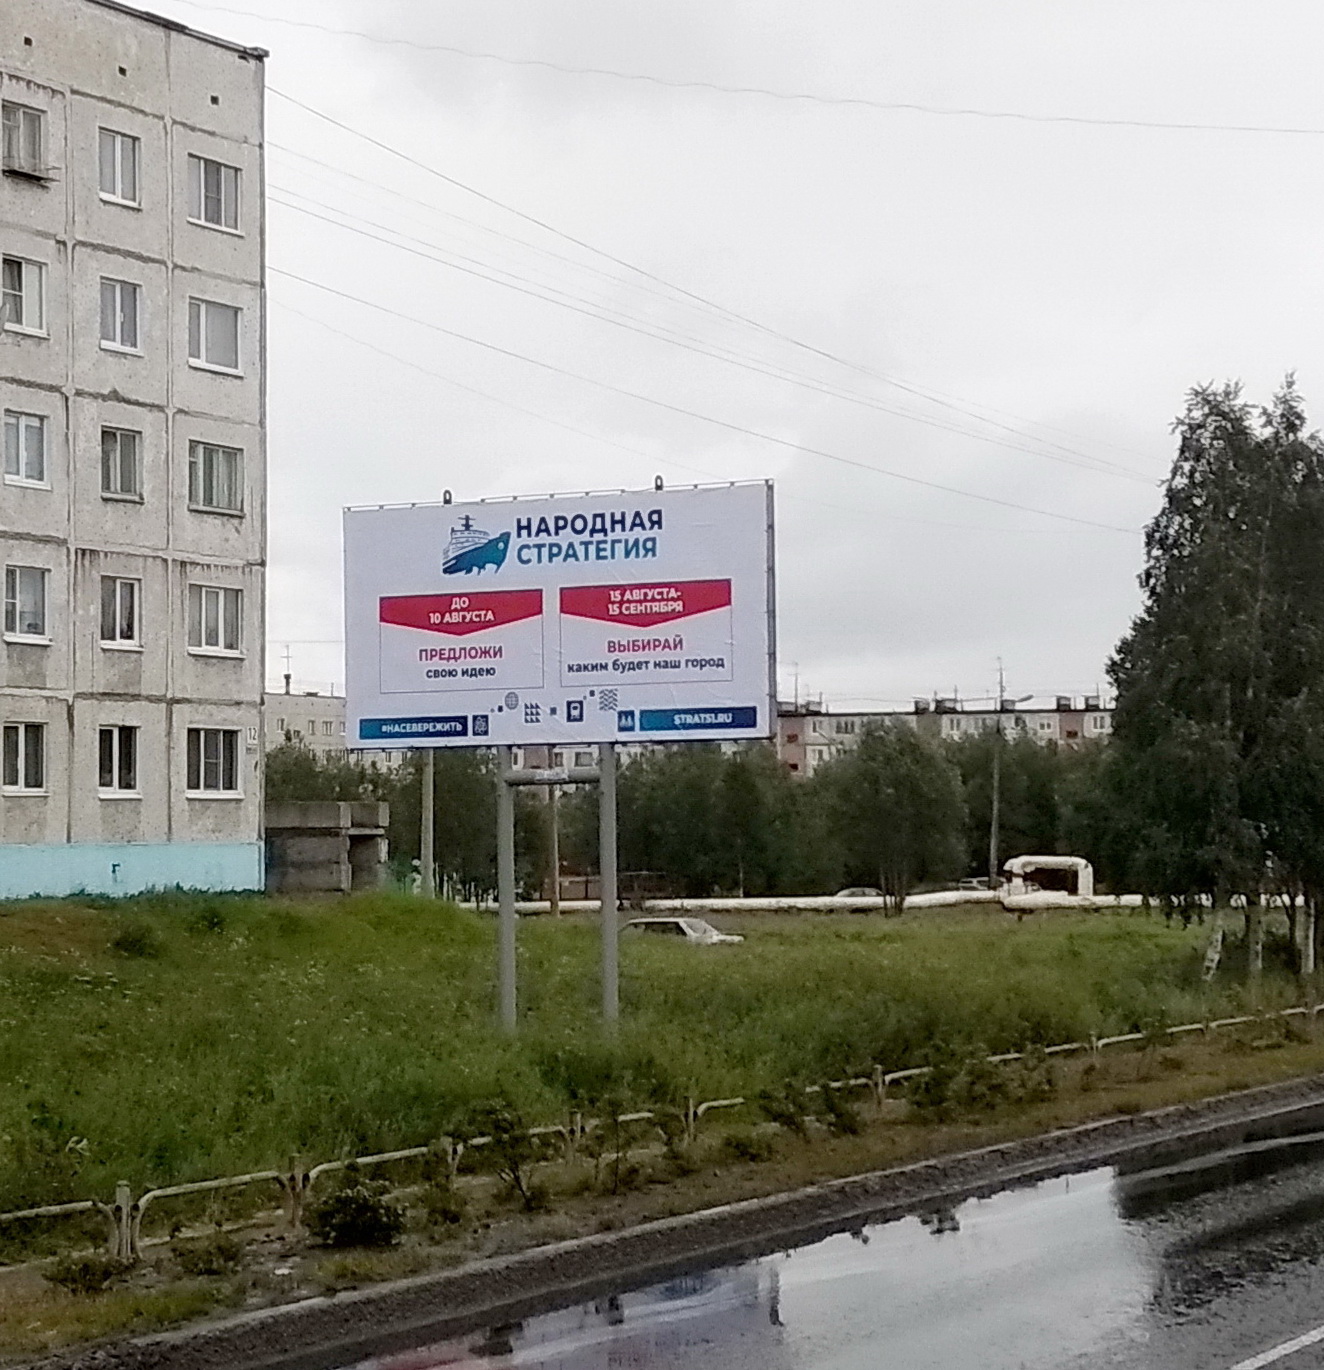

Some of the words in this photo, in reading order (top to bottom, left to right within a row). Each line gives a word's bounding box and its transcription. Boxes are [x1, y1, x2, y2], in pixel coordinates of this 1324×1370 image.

[516, 509, 663, 539] НАРОДНАЯ
[516, 537, 657, 565] СТРАТЕГИЯ
[610, 591, 621, 602] 15
[624, 588, 681, 601] АВГУСТА-
[451, 597, 469, 610] ДО
[608, 604, 619, 615] 15
[621, 601, 683, 615] СЕНТЯБРЯ
[429, 613, 441, 624] 10
[443, 610, 495, 623] АВГУСТА
[607, 635, 683, 653] ВЫБИРАЙ
[419, 645, 503, 662] ПРЕДЛОЖИ
[567, 662, 608, 673] каким
[612, 658, 649, 674] будет
[653, 659, 681, 670] наш
[685, 657, 725, 670] город
[426, 669, 458, 679] свою
[461, 667, 496, 678] идею
[248, 727, 257, 740] 12
[381, 722, 463, 733] #НАСЕВЕРЕЖИТЬ
